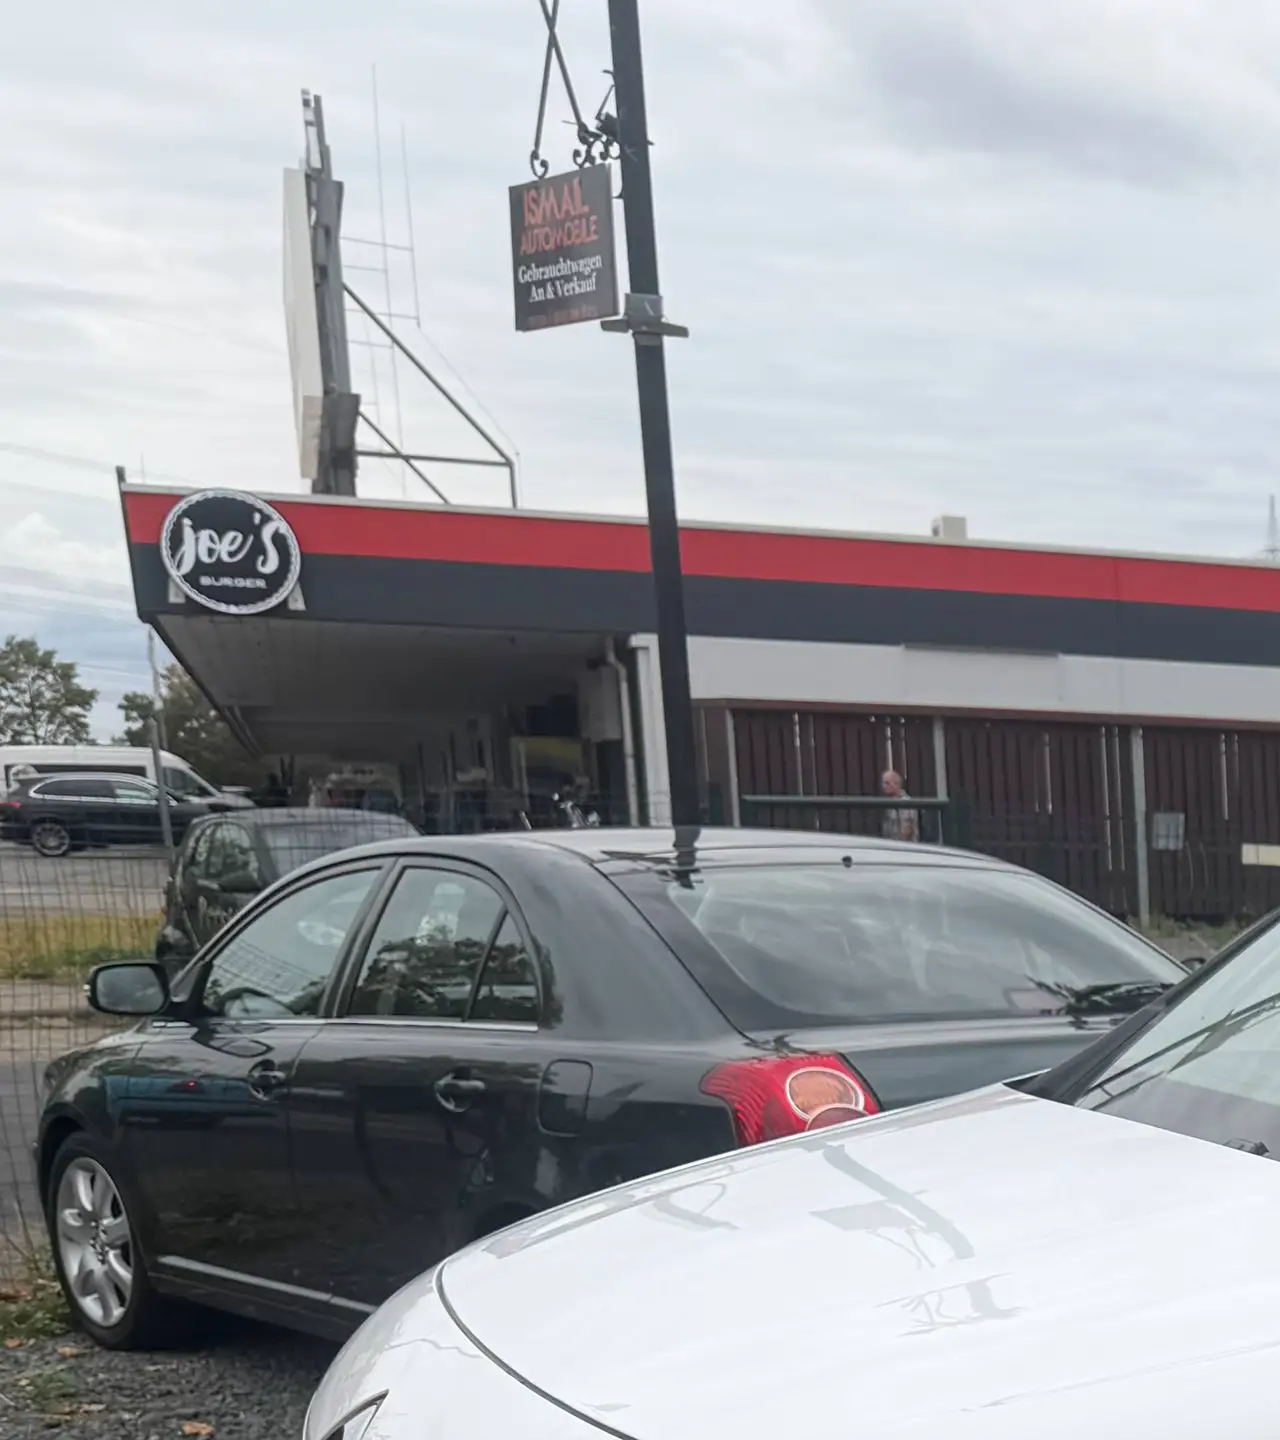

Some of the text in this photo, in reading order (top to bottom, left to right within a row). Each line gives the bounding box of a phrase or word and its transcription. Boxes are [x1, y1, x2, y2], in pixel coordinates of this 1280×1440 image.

[524, 177, 589, 226] ISMAIL
[520, 215, 598, 255] AUTOMOBILE
[518, 255, 602, 283] Gebrauchtwagen
[529, 273, 597, 302] An & Verkauf
[199, 576, 267, 590] BURGER
